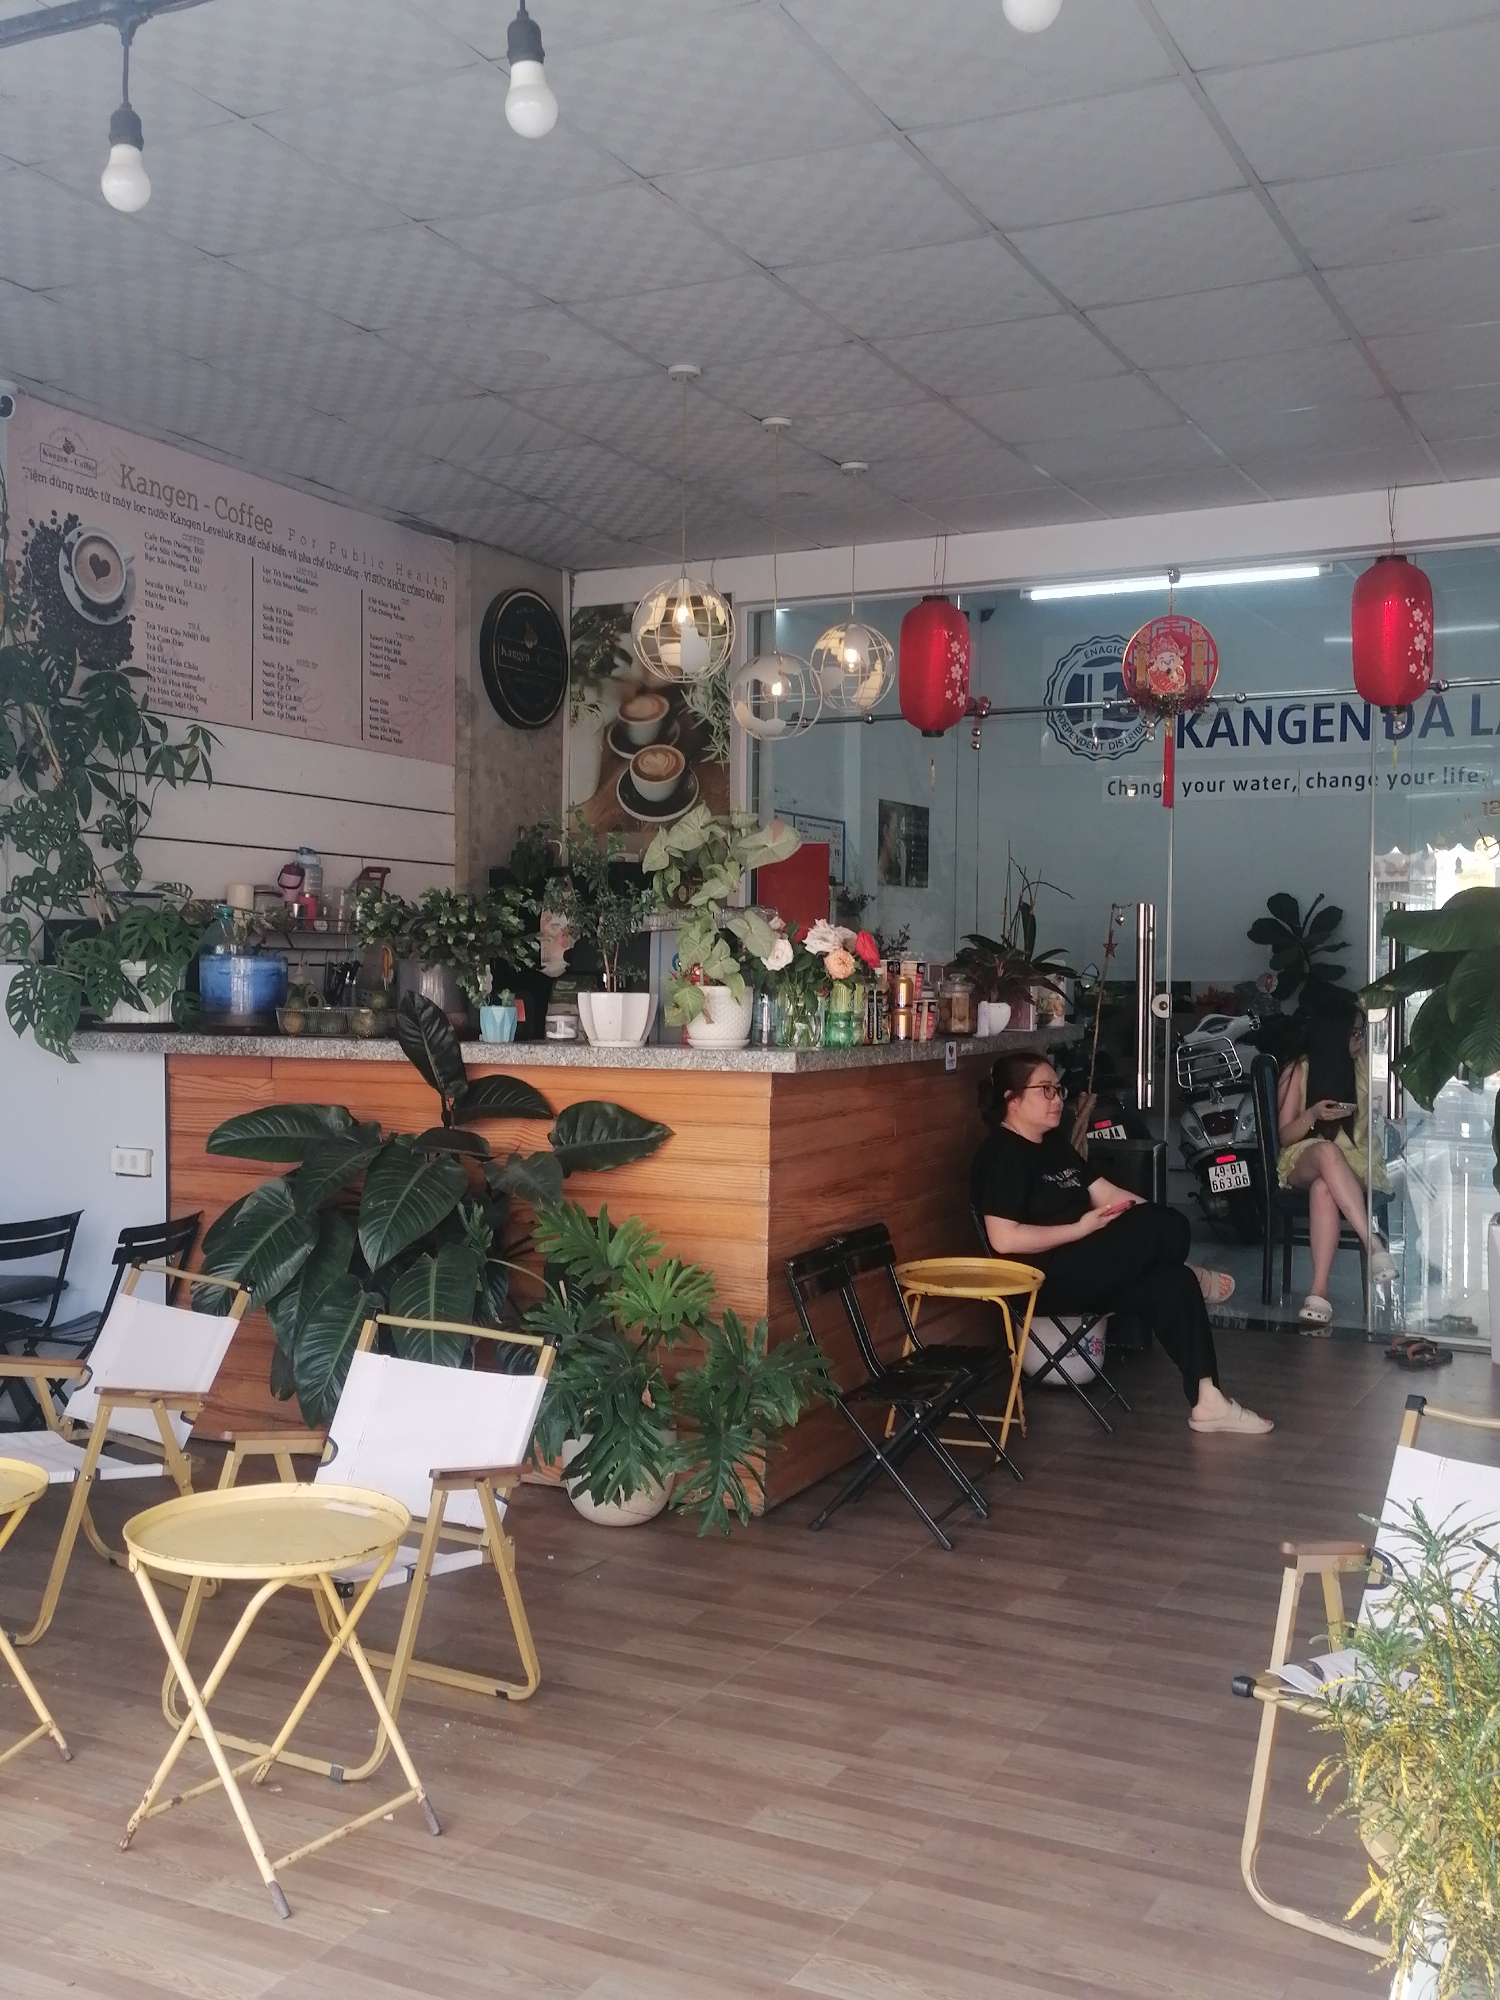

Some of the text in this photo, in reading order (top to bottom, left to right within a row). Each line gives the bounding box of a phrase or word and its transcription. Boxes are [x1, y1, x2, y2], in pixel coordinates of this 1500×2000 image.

[42, 448, 68, 463] Kangen
[120, 463, 199, 512] Kangen
[214, 496, 273, 535] Coffee
[22, 466, 47, 484] Tiệm
[49, 475, 73, 493] dùng
[76, 485, 99, 499] nước
[112, 495, 131, 511] máy
[133, 500, 146, 515] lọc
[148, 507, 168, 521] nước
[170, 512, 201, 531] Kangen
[203, 522, 234, 540] Leveluk
[288, 549, 297, 560] và
[298, 552, 312, 565] pha
[288, 528, 448, 590] For Public Health
[501, 645, 529, 662] Kangen
[1083, 645, 1124, 659] ENAGIC
[1056, 708, 1105, 751] NDEPENDENT
[1176, 702, 1371, 749] KANGEN
[1107, 780, 1163, 798] Chang
[1181, 779, 1225, 797] your
[1233, 775, 1298, 793] water,
[1387, 769, 1436, 789] your
[1443, 767, 1486, 785] life.
[1212, 1175, 1249, 1191] 663.06
[1215, 1163, 1242, 1177] 49-B1
